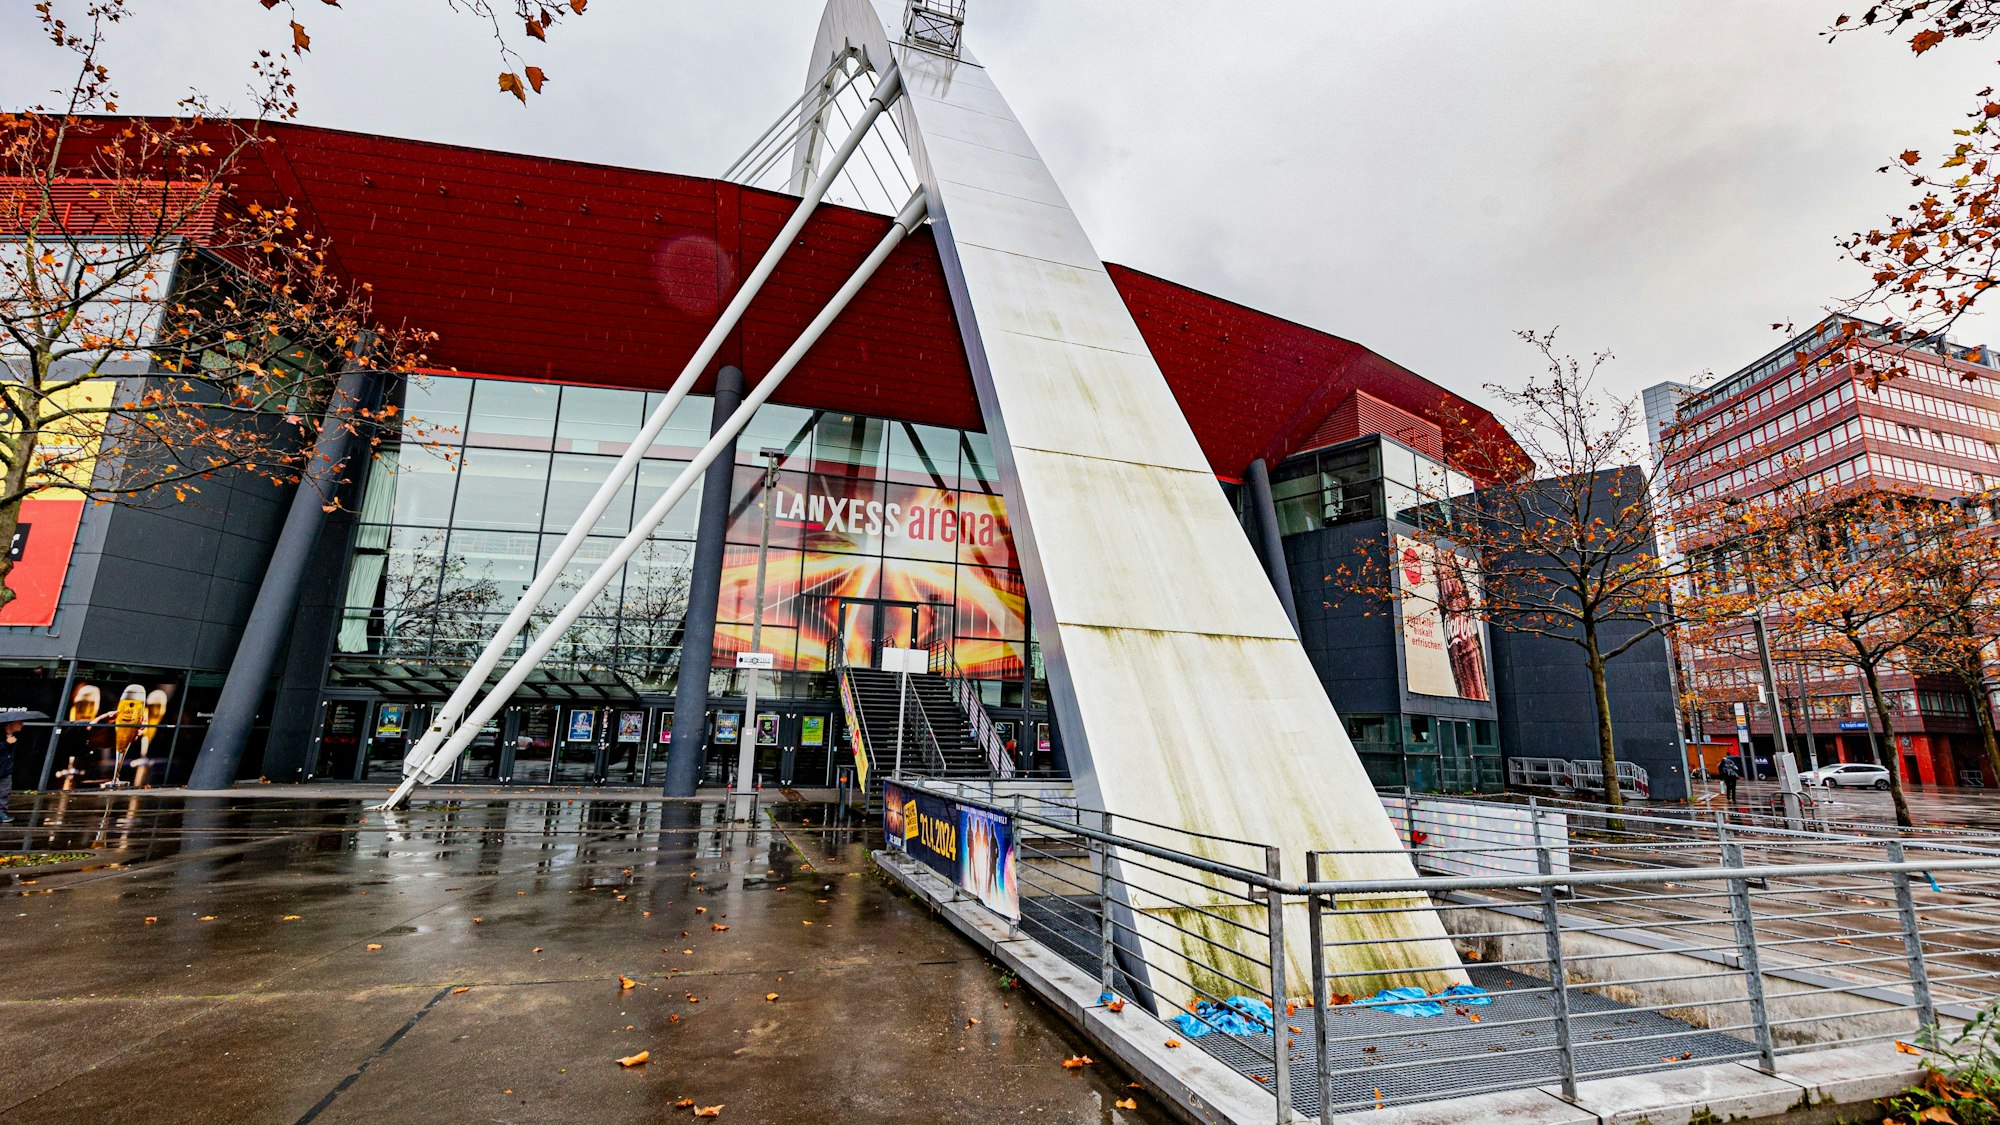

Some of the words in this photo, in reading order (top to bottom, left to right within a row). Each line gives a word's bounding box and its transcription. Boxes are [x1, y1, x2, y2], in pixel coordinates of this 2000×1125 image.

[775, 491, 901, 537] LANXESS
[908, 505, 994, 547] arena
[1414, 627, 1433, 638] eiskalt
[1411, 637, 1443, 650] erfrischen!
